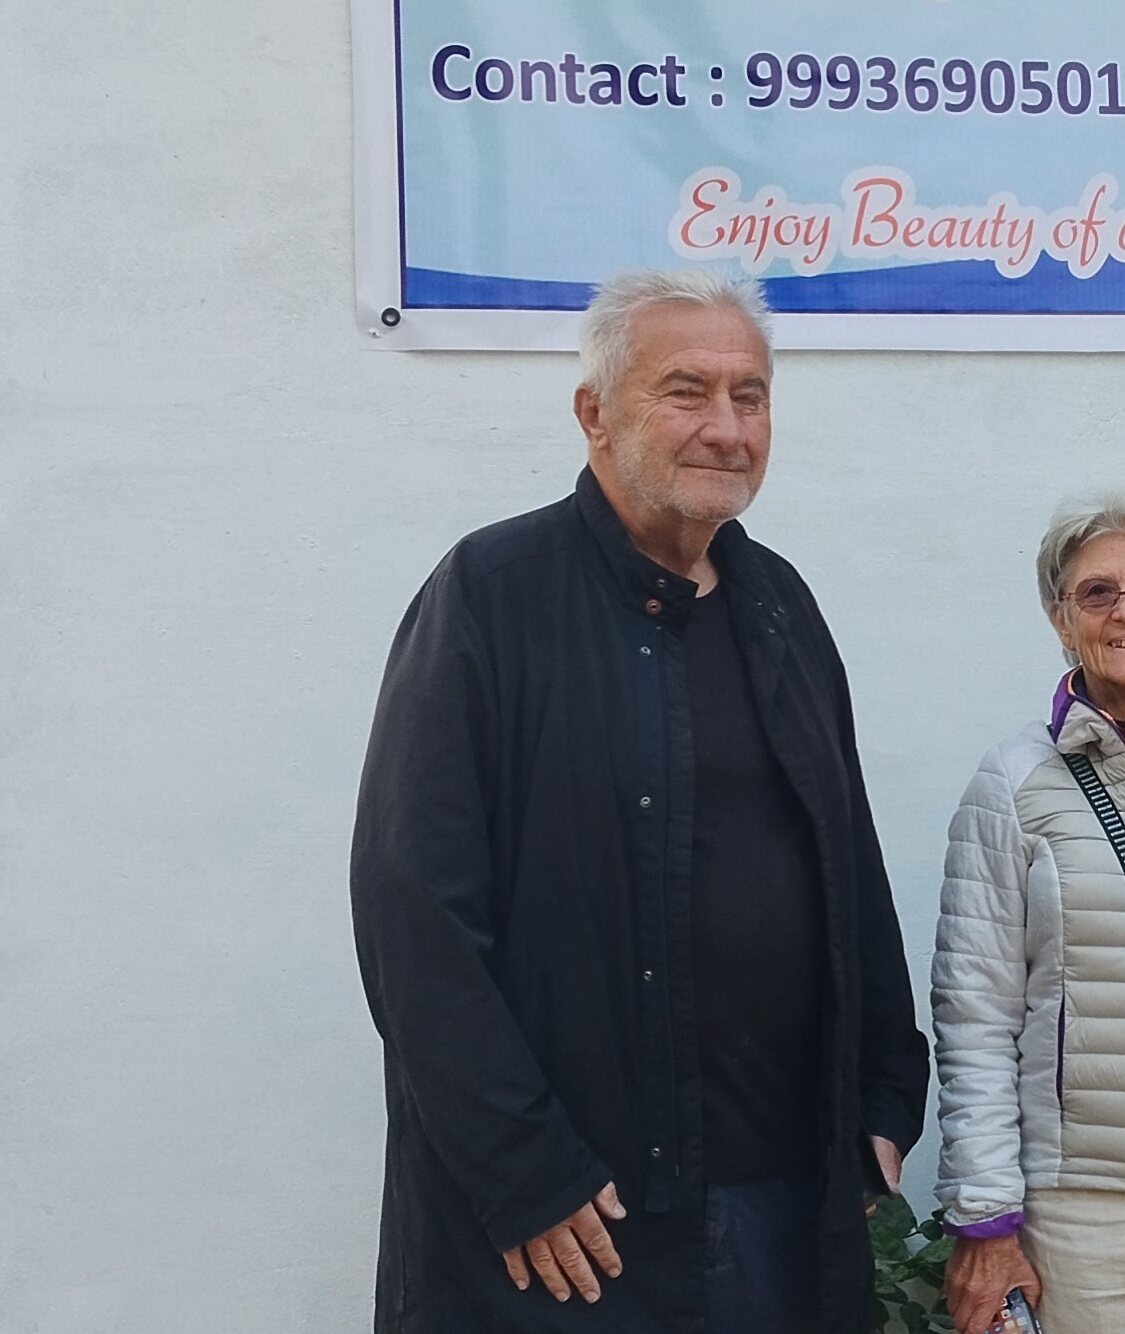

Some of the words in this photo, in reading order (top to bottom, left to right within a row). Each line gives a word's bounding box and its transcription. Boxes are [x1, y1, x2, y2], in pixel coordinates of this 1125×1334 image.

[431, 44, 686, 106] Contact
[680, 179, 830, 264] Enjoy
[852, 177, 1034, 266] Beauty
[1052, 184, 1107, 267] of
